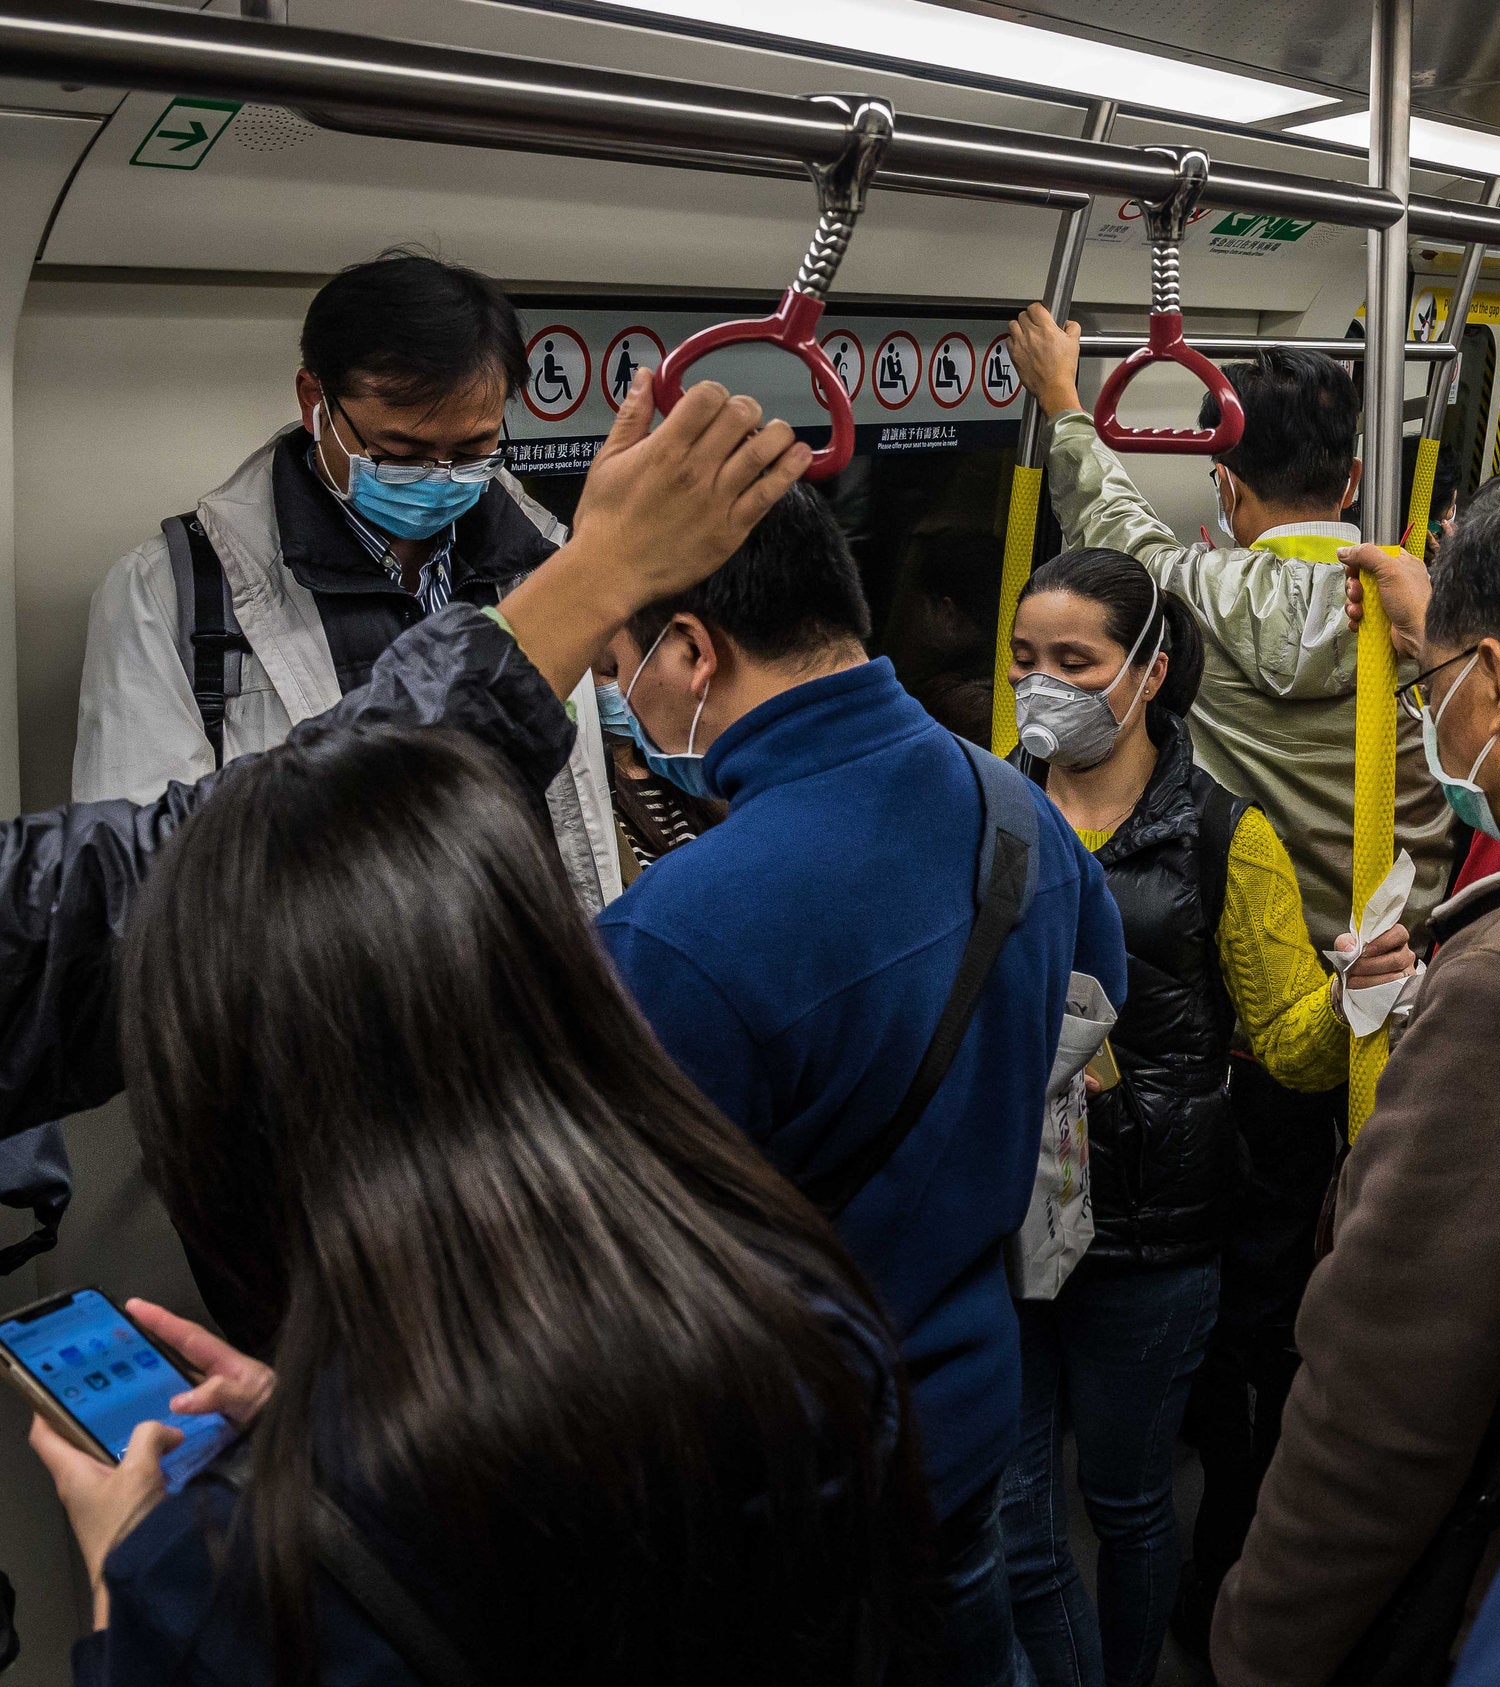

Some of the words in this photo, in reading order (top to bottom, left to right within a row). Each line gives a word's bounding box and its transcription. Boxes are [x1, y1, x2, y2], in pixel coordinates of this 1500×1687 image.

[1479, 302, 1488, 314] the
[1488, 305, 1500, 317] gap
[878, 442, 892, 450] Please
[902, 442, 912, 450] your
[511, 462, 528, 471] Multi
[528, 461, 554, 472] purpose
[555, 461, 572, 469] space
[573, 459, 582, 468] for
